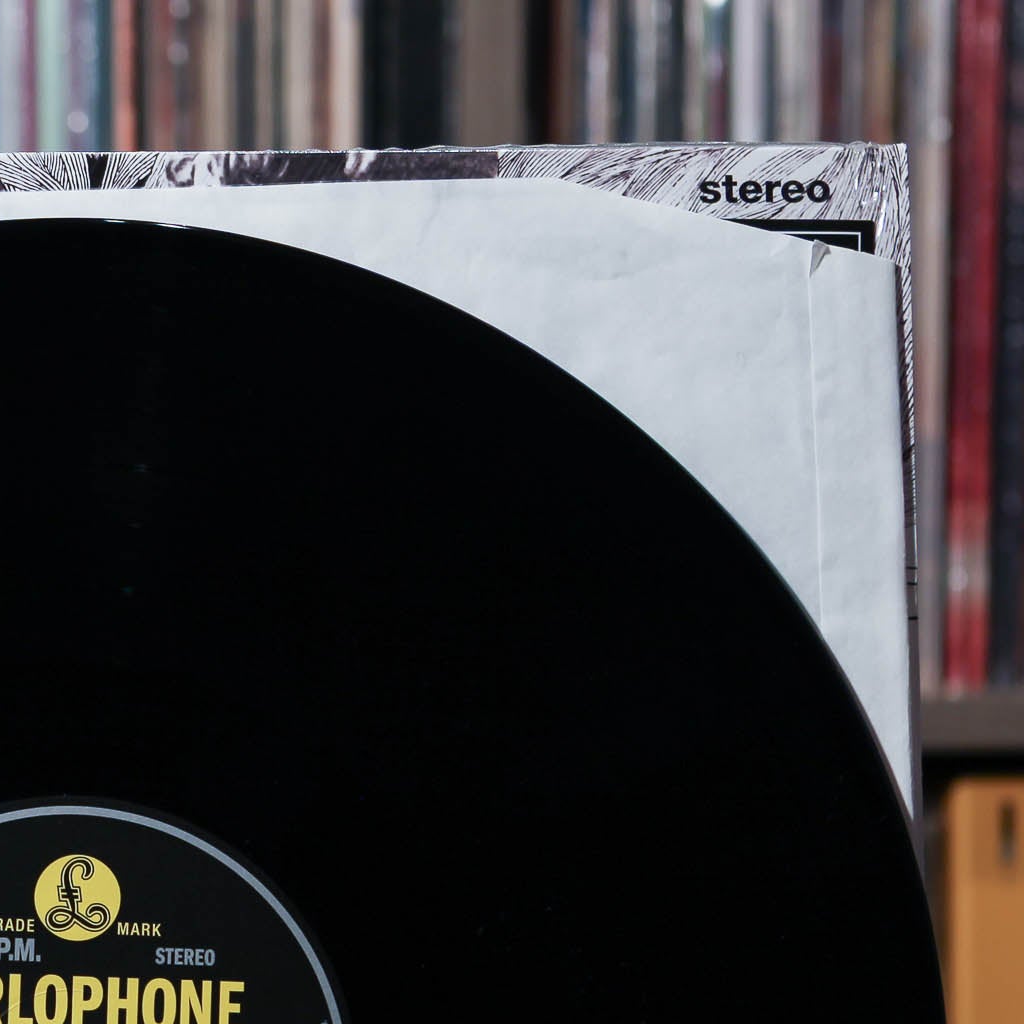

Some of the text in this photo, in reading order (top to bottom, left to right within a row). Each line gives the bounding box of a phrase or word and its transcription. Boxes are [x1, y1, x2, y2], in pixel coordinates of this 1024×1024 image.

[699, 174, 831, 203] stereo
[117, 921, 162, 937] MARK
[155, 947, 215, 966] STEREO
